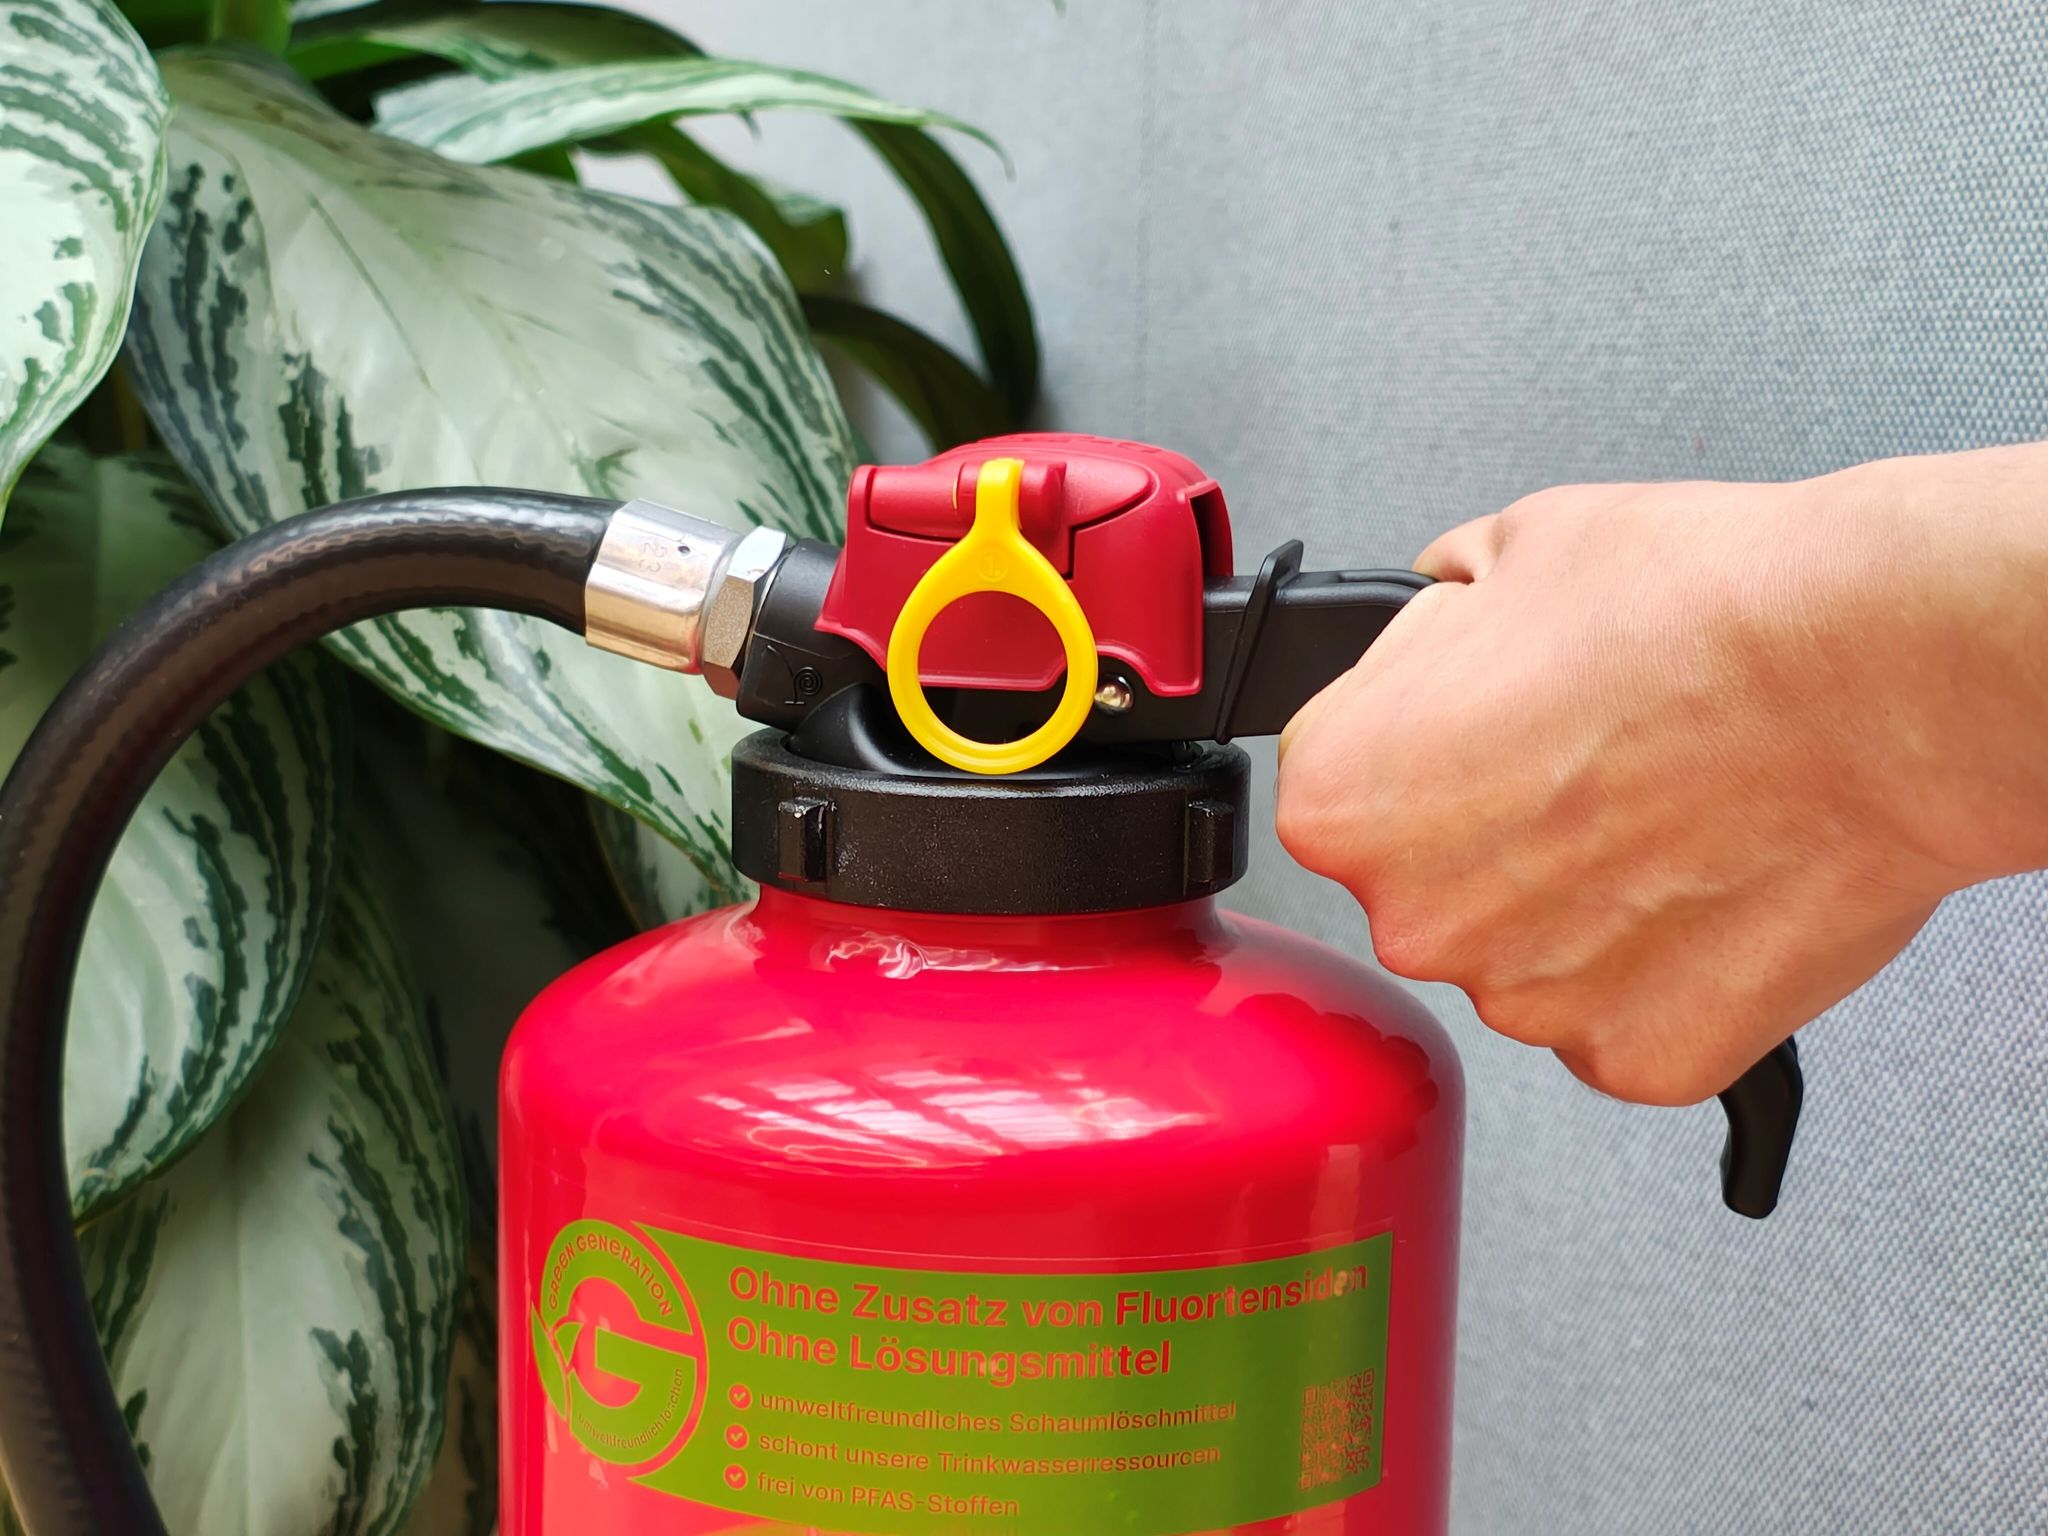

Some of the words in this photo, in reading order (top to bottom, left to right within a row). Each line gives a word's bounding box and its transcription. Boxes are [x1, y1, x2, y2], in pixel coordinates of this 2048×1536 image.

[729, 1266, 840, 1314] Ohne
[852, 1283, 1008, 1327] Zusatz
[1021, 1299, 1103, 1328] von
[1115, 1264, 1368, 1326] Fluortensiden
[728, 1315, 838, 1365] Ohne
[850, 1335, 1172, 1388] Lösungsmittel
[578, 1413, 664, 1449] umweltfreundlich
[760, 1393, 1001, 1432] umweltfreundliches
[1009, 1400, 1236, 1433] Schaumlöschmittel
[759, 1434, 838, 1462] schont
[846, 1447, 930, 1471] unsere
[937, 1446, 1221, 1475] Trinkwasserressourcen
[757, 1471, 796, 1497] frei
[801, 1482, 844, 1504] von
[851, 1485, 1020, 1517] PFAS-Stoffen
